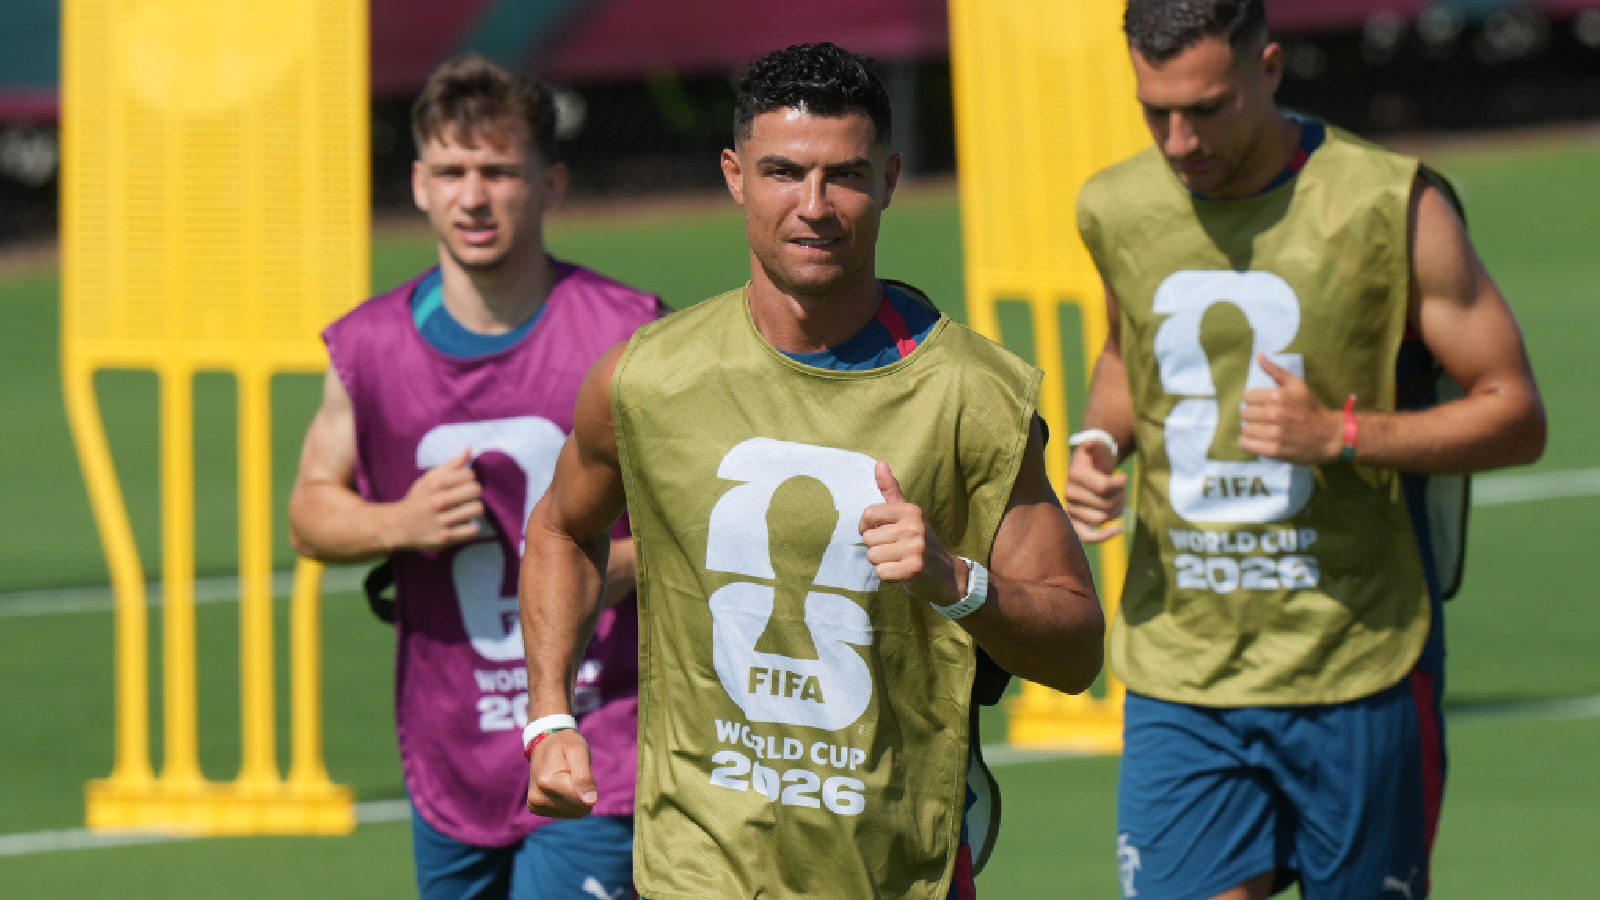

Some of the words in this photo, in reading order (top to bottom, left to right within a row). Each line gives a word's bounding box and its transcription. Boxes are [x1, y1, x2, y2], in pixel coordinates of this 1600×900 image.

[1202, 475, 1272, 498] FIFA
[1169, 527, 1257, 555] WORLD
[1260, 527, 1318, 555] CUP
[1173, 554, 1321, 594] 2026
[474, 668, 528, 693] WOR
[748, 666, 825, 704] FIFA
[715, 718, 804, 760] WORLD
[810, 741, 867, 771] CUP
[709, 750, 867, 816] 2026
